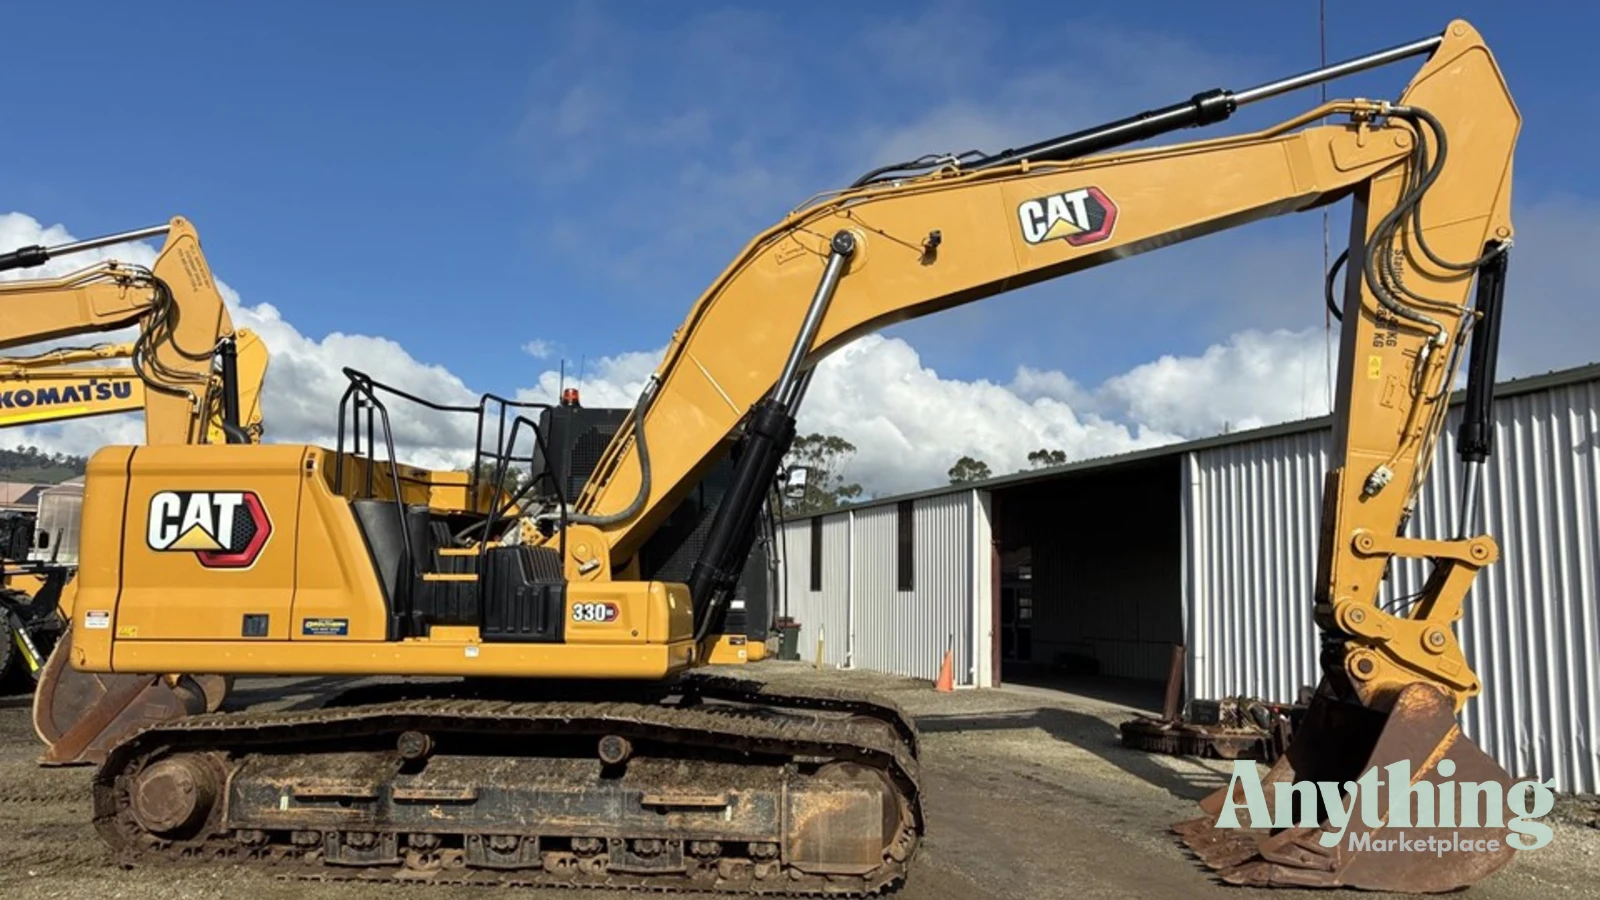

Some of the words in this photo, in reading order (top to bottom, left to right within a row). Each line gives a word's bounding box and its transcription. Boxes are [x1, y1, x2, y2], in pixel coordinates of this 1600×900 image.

[1019, 189, 1091, 243] CAT
[1372, 332, 1385, 348] KG
[1386, 331, 1398, 347] KG
[149, 491, 243, 550] CAT
[572, 603, 606, 621] 330
